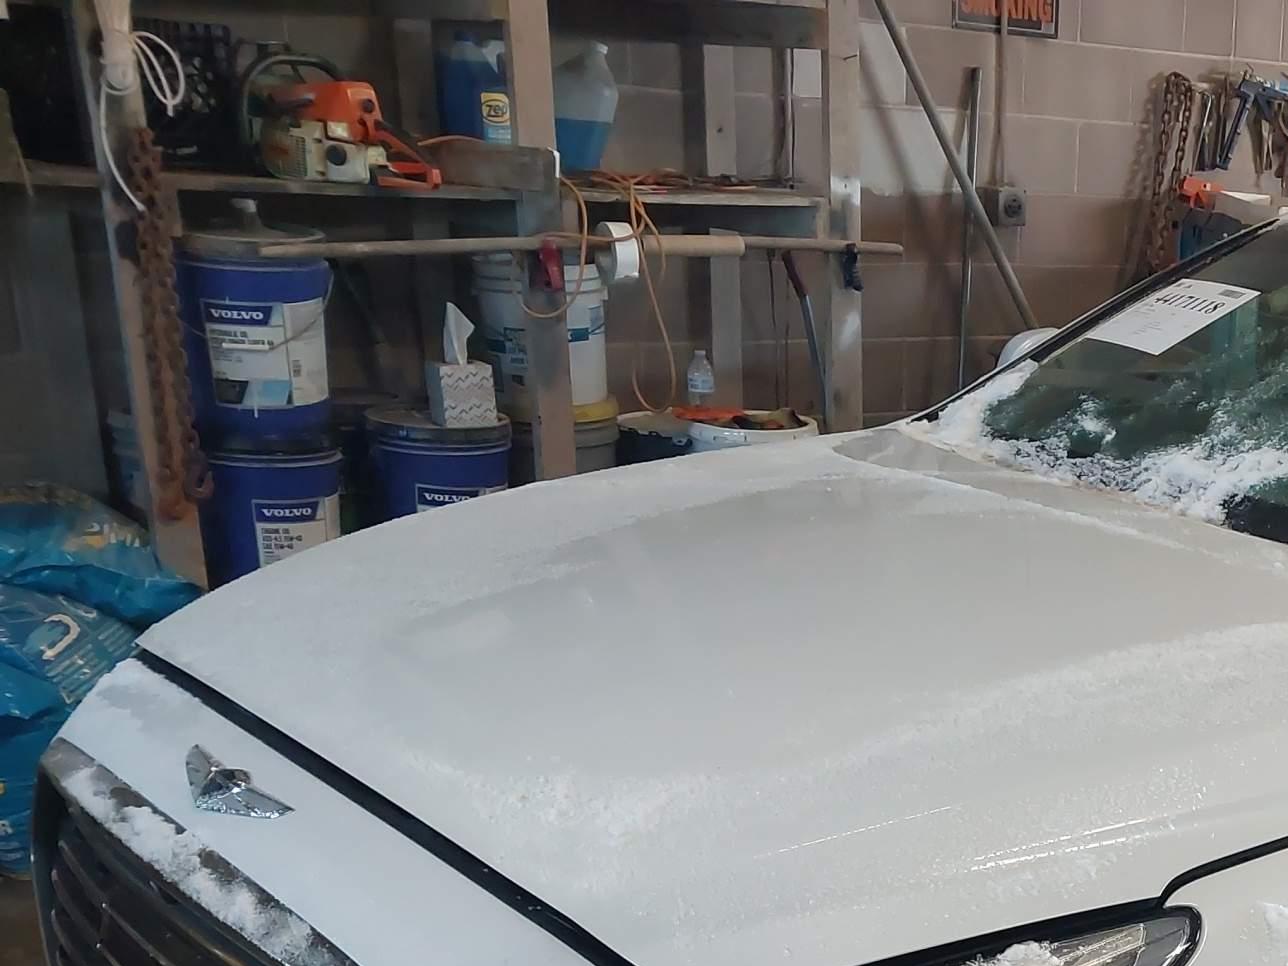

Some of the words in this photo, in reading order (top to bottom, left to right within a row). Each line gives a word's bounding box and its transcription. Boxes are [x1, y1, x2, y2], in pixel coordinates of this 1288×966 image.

[1155, 293, 1225, 314] 44171118
[209, 308, 263, 319] VOLVO
[261, 507, 312, 518] VOLVO
